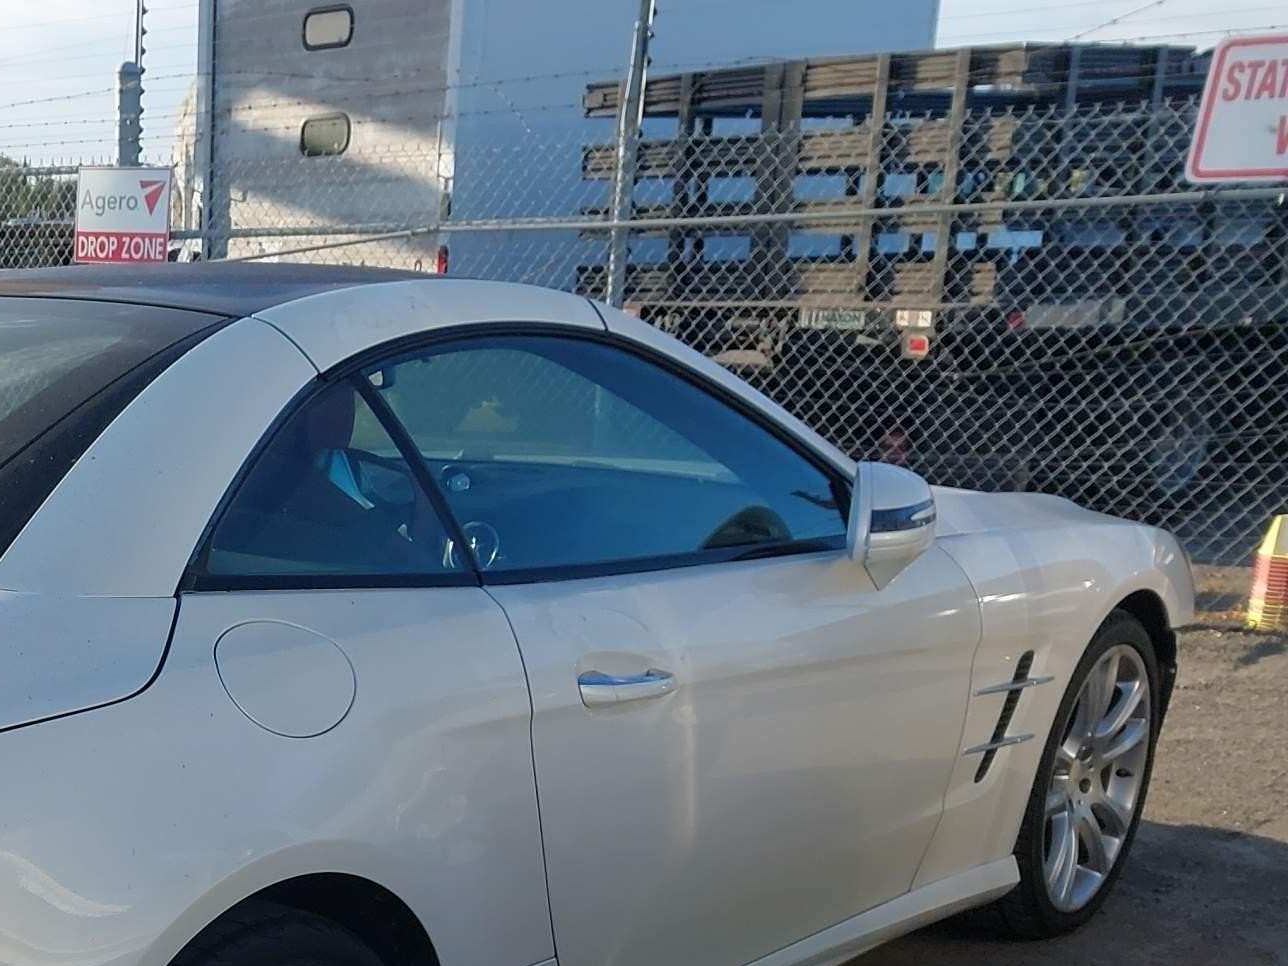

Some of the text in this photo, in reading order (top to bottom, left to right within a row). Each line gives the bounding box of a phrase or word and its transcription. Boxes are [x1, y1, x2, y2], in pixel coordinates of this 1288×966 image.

[81, 188, 138, 216] Agero
[78, 235, 164, 260] DROP ZONE
